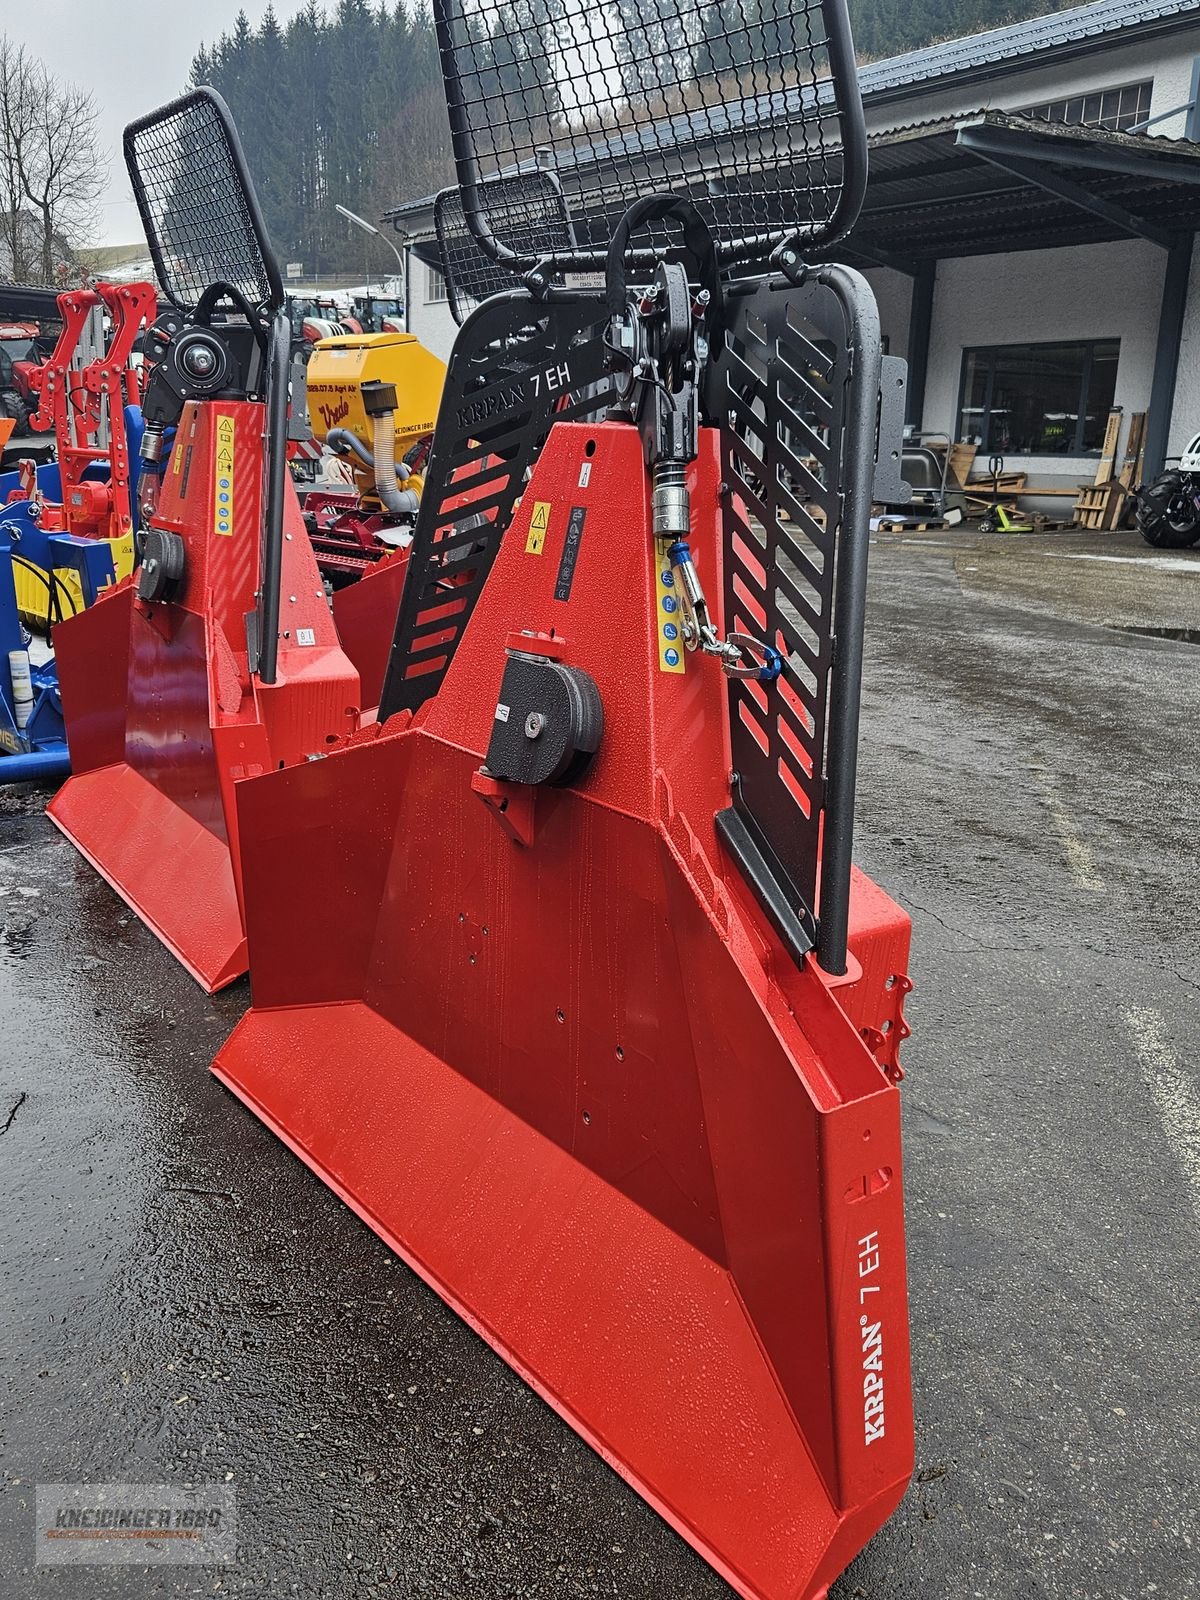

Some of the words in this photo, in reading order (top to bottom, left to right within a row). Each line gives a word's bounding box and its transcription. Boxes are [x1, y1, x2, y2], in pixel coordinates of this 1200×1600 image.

[530, 374, 541, 397] 7
[545, 361, 571, 391] EH
[318, 395, 350, 431] Vredo
[395, 423, 421, 434] NEIDINGER
[858, 1230, 880, 1278] EH
[860, 1286, 881, 1305] 7
